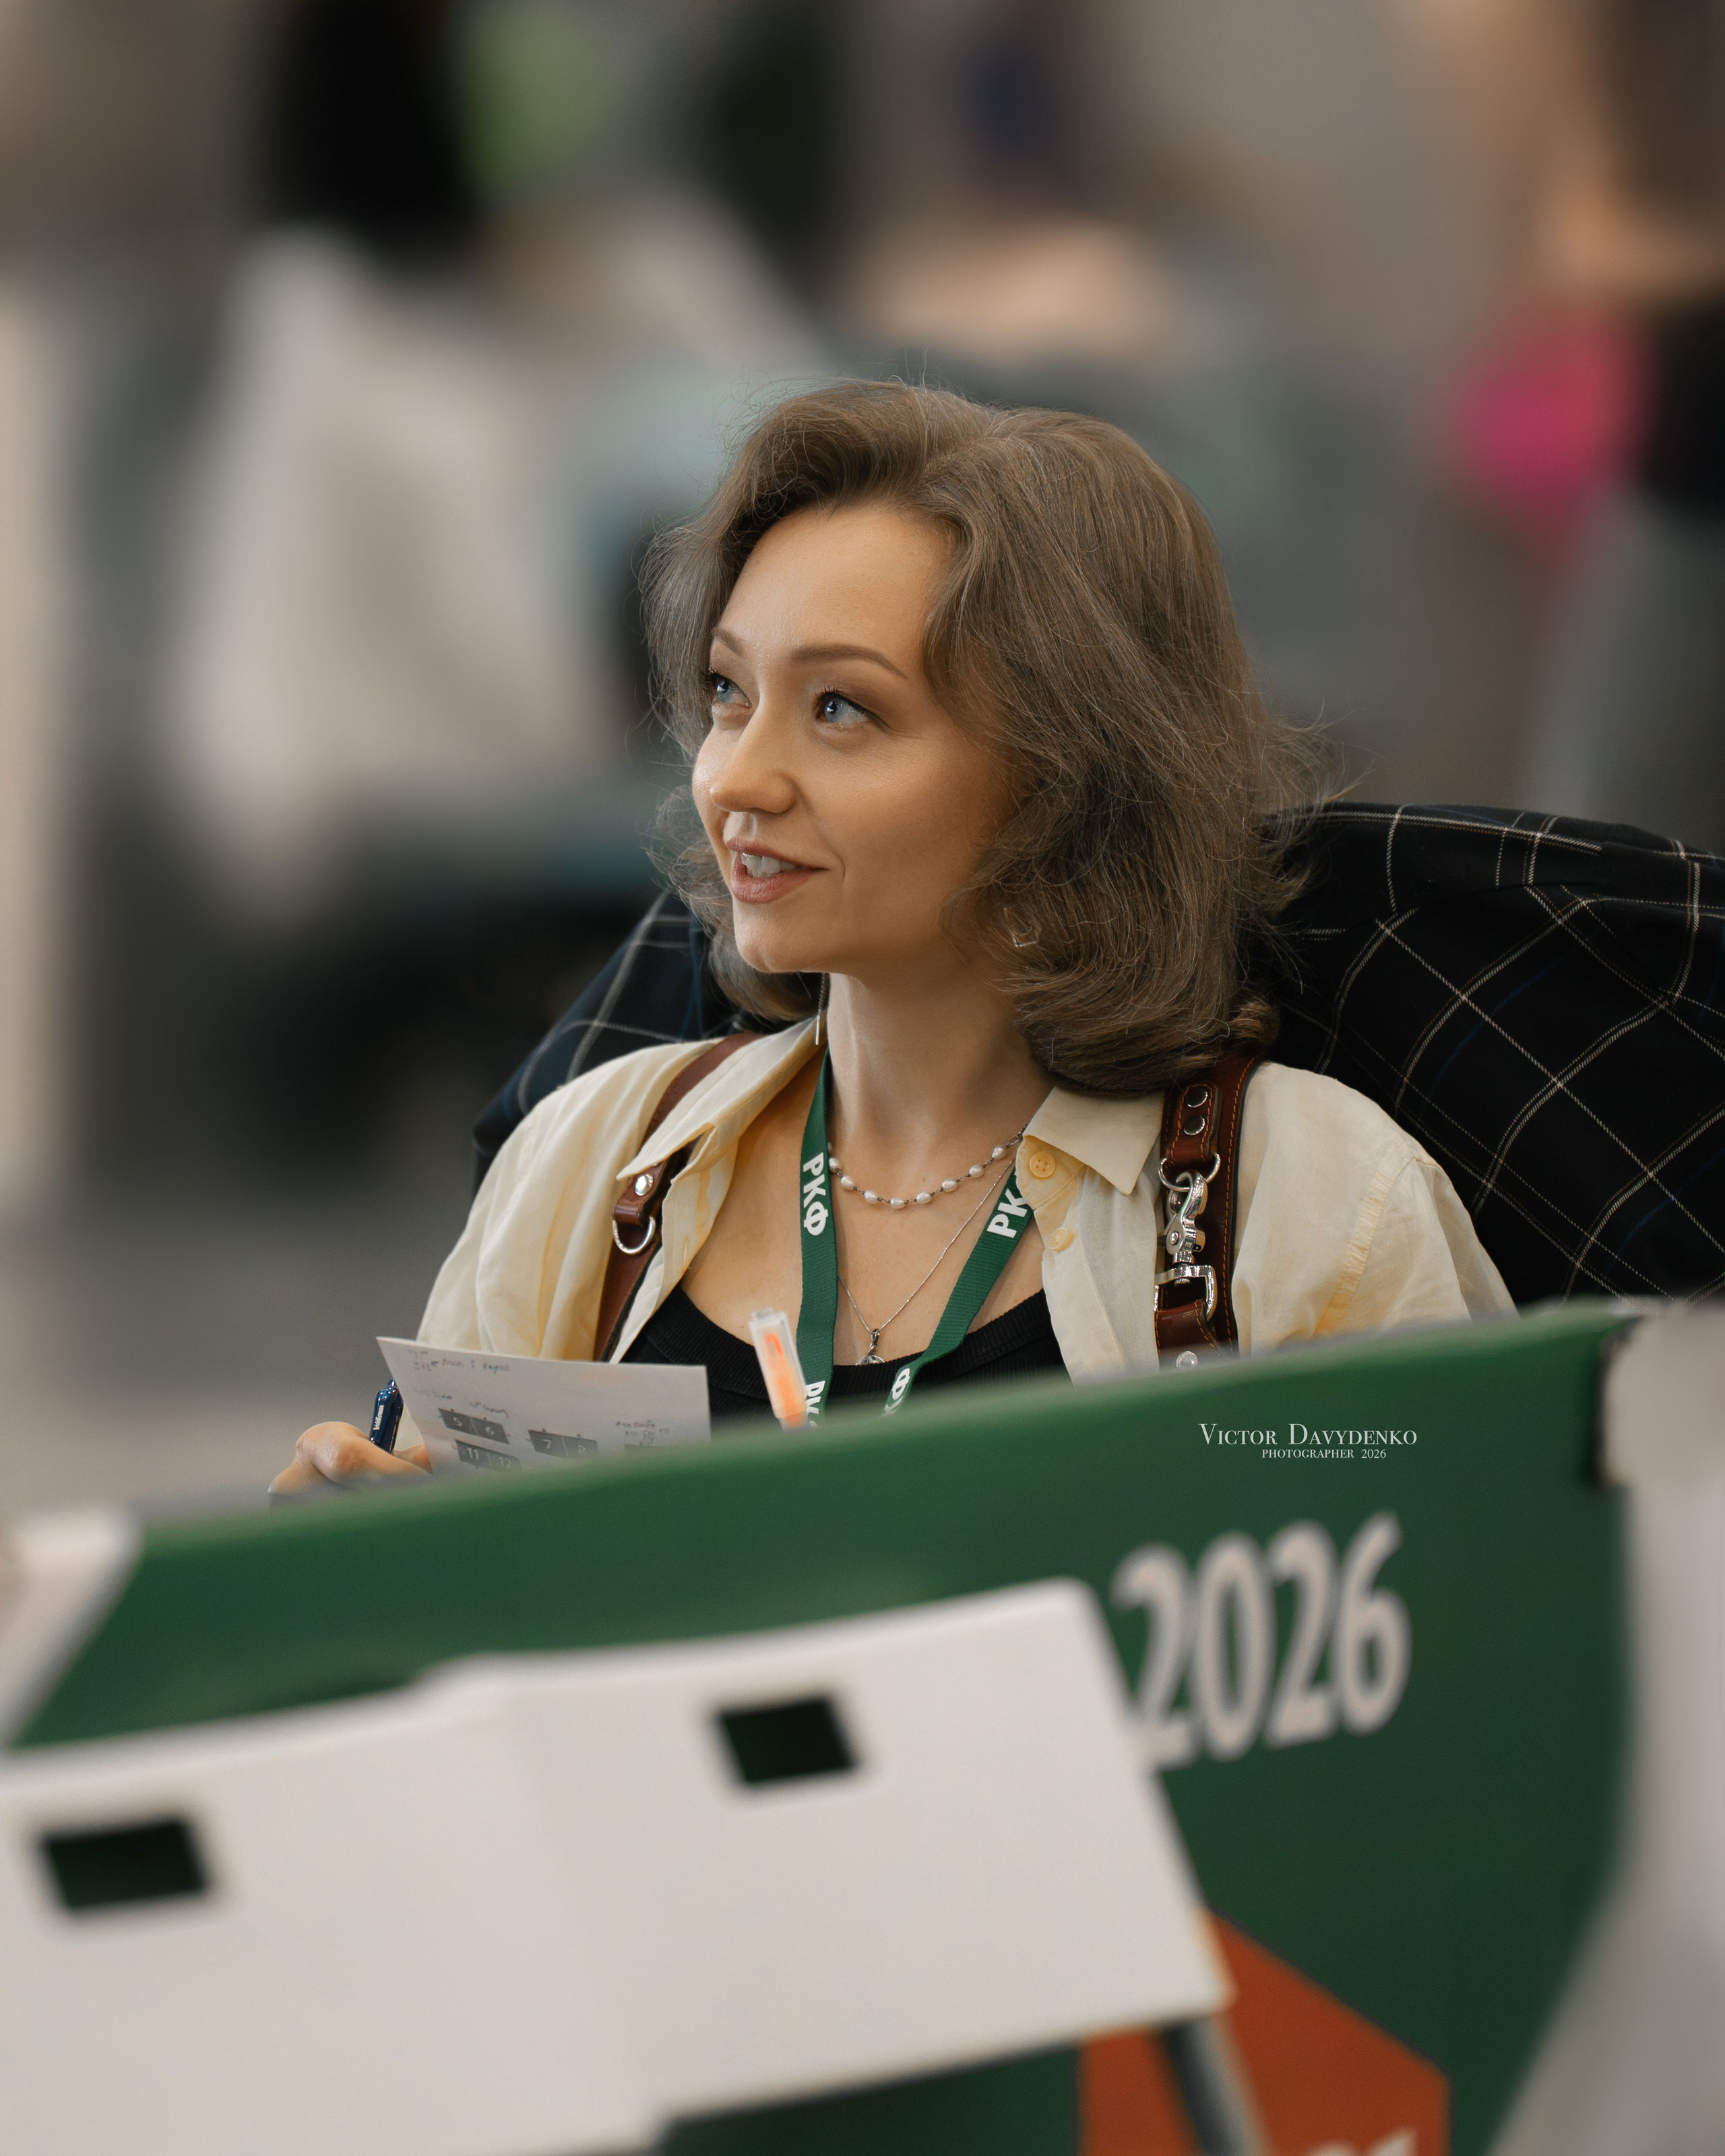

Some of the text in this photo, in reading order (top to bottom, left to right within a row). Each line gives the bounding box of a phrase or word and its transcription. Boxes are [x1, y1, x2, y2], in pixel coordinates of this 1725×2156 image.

[803, 1152, 829, 1236] РКФ
[987, 1188, 1028, 1239] РК
[1112, 1510, 1412, 1770] 2026
